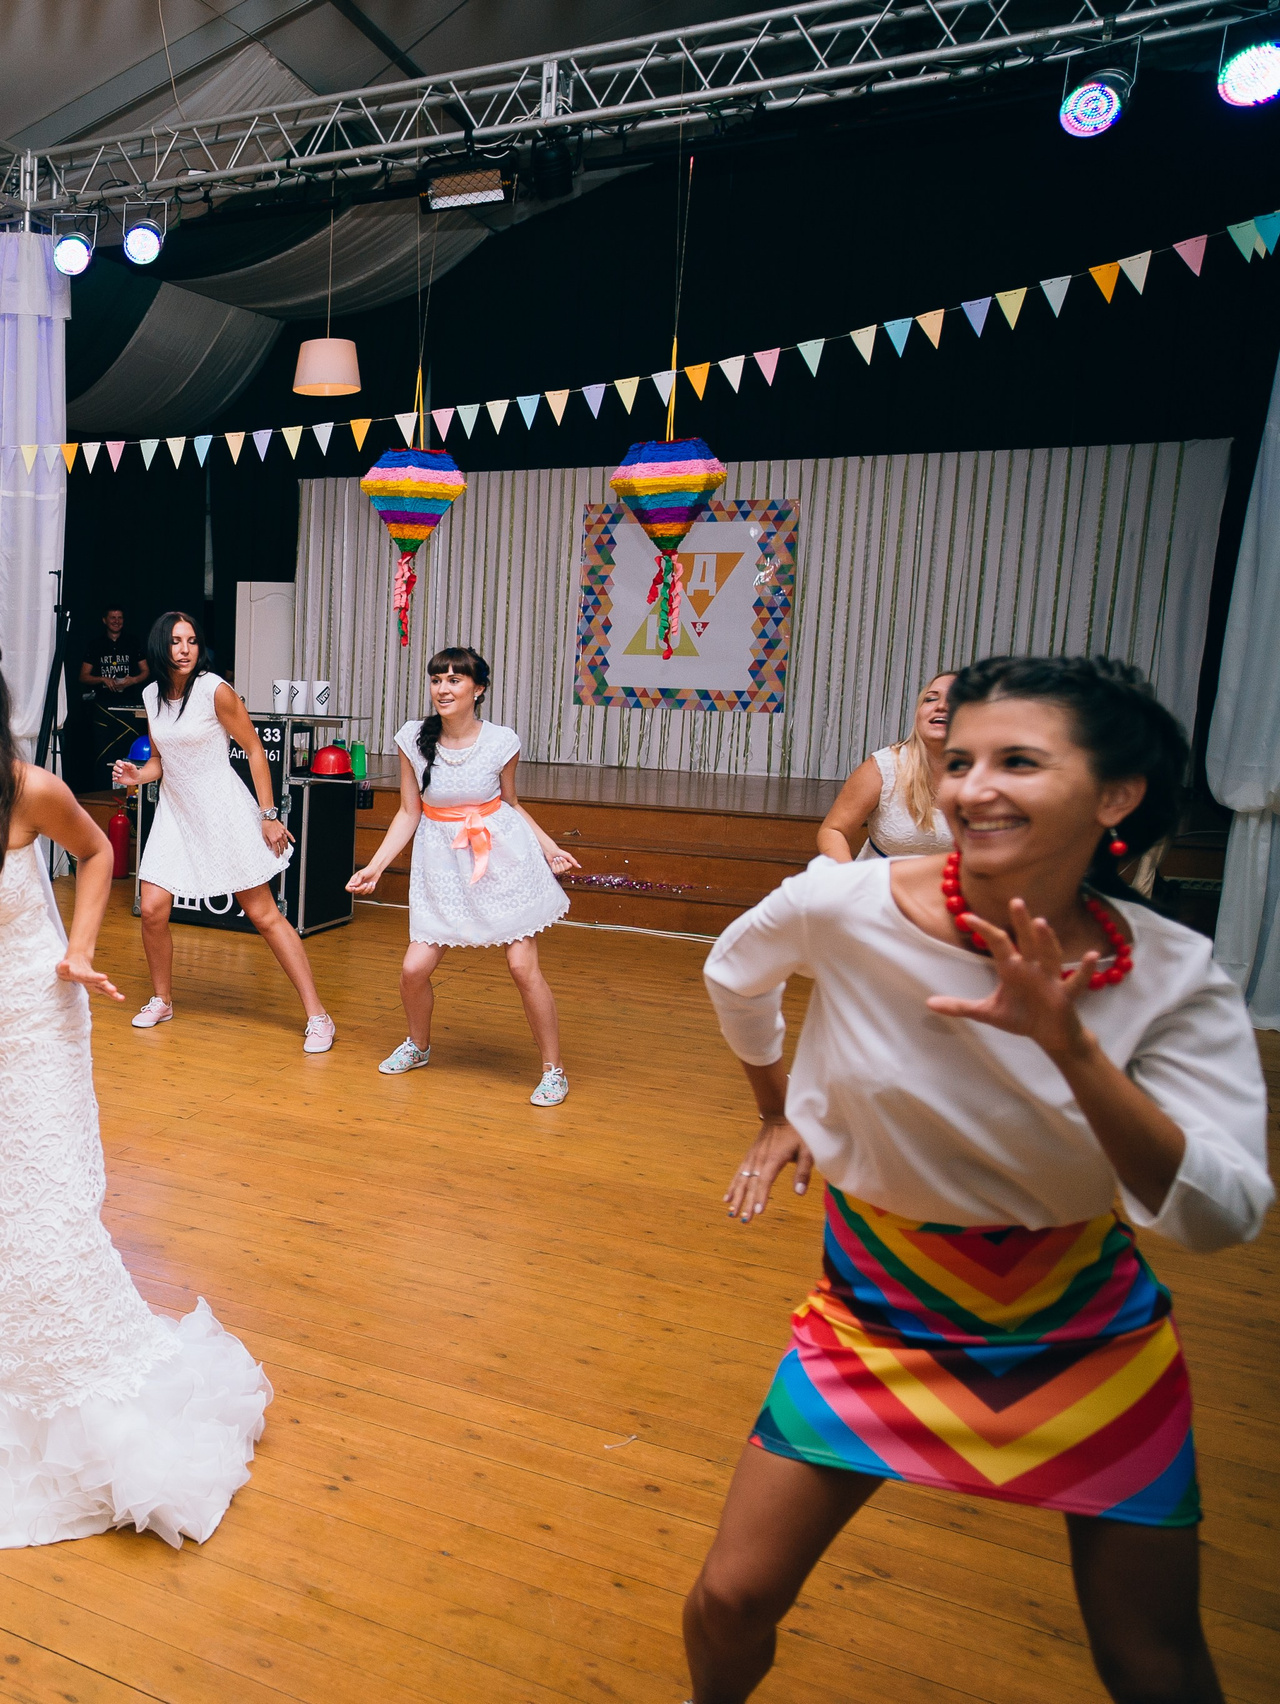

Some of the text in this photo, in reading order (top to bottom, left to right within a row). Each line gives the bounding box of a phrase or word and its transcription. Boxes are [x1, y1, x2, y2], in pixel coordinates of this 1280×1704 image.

[686, 553, 717, 597] Д
[695, 622, 705, 633] &
[116, 654, 129, 663] BAR
[262, 727, 282, 743] 33
